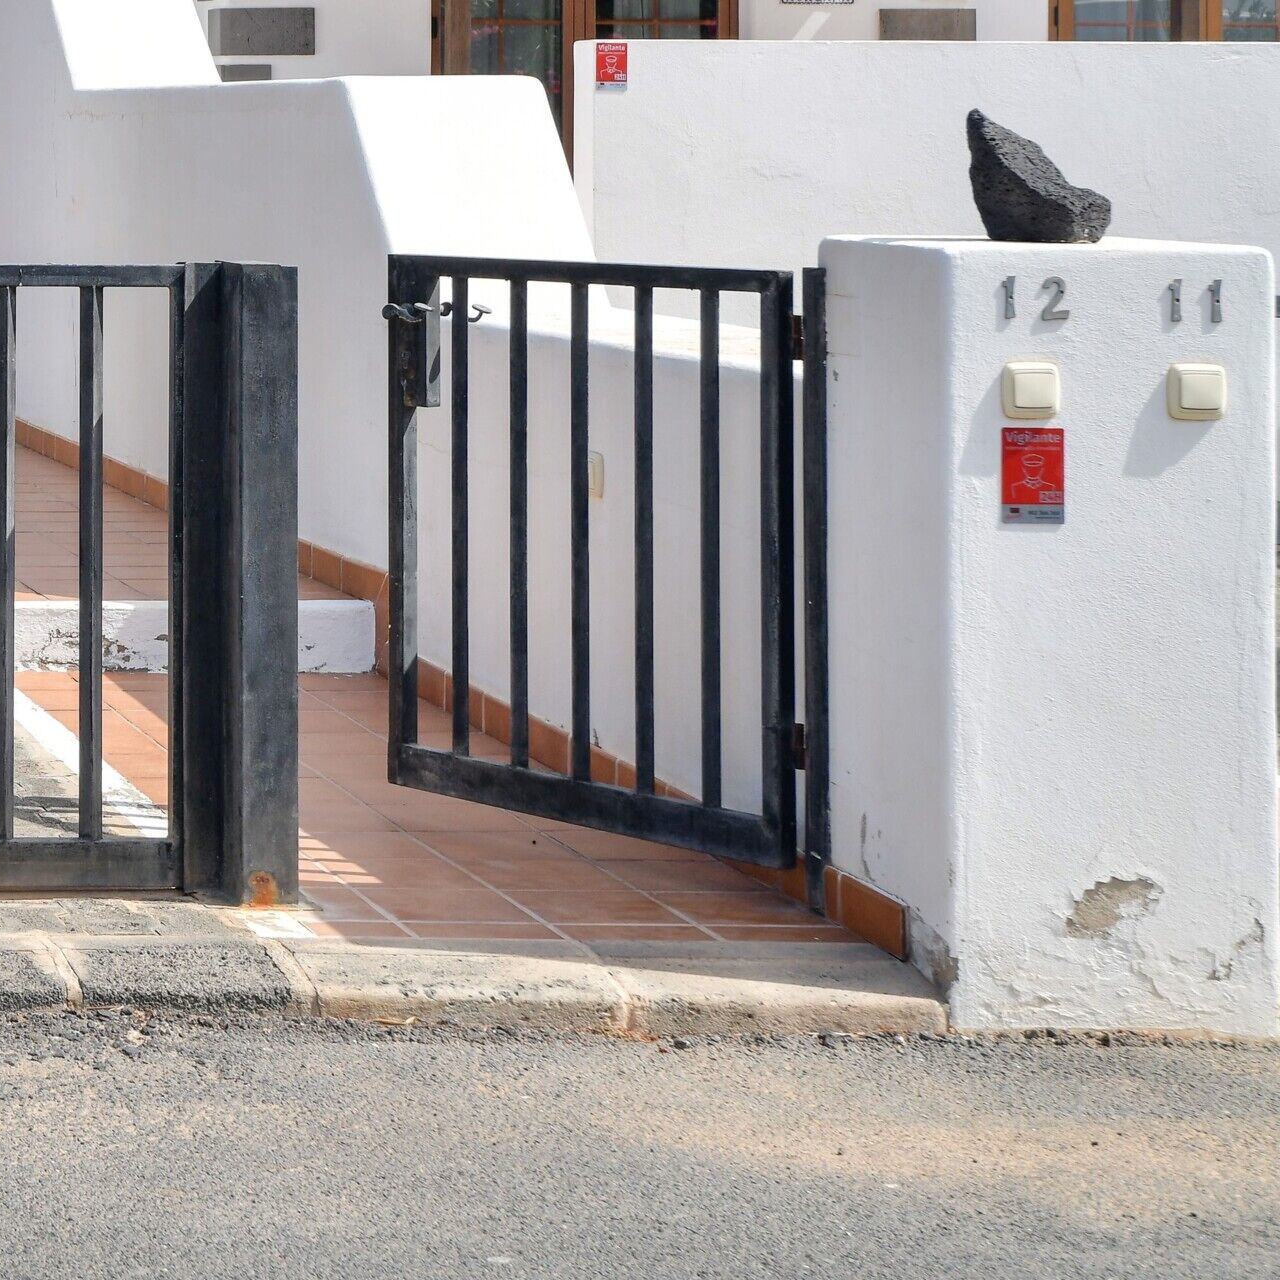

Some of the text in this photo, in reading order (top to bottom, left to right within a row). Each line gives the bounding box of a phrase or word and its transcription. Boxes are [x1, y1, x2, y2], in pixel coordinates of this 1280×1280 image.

[1001, 275, 1070, 321] 12
[1168, 278, 1223, 323] 11
[1004, 431, 1061, 445] Vigilante
